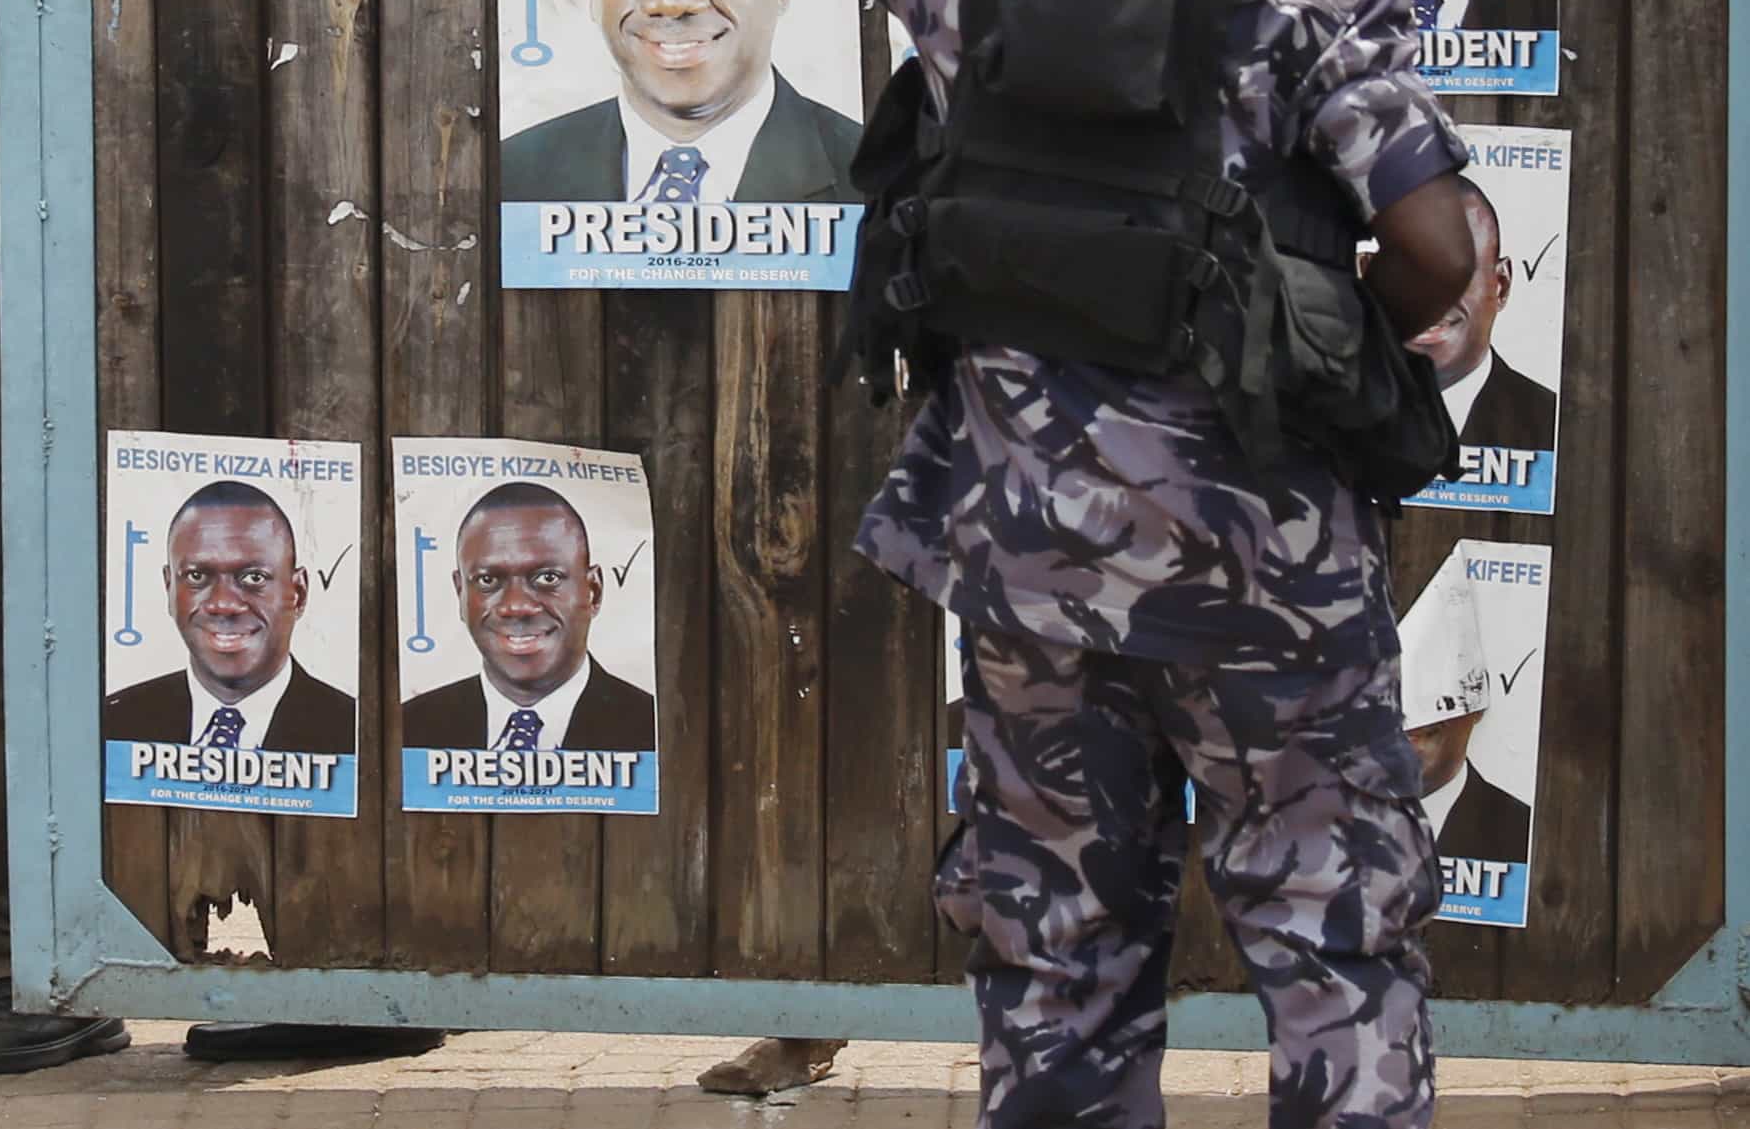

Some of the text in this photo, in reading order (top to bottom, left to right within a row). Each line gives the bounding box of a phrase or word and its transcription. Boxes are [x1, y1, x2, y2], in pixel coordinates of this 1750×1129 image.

[1412, 29, 1538, 68] IDENT
[1485, 145, 1562, 170] KIFEFE
[540, 205, 838, 255] PRESIDENT
[569, 268, 809, 282] FOR THE CHANGE WE DESERVE
[647, 257, 719, 266] 2016-2021
[117, 448, 353, 481] BESIGYE KIZZA KIFEFE
[402, 451, 640, 483] BESIGYE KIZZA KIFEFE
[1466, 558, 1542, 585] KIFEFE
[131, 743, 335, 790] PRESIDENT
[427, 749, 637, 788] PRESIDENT
